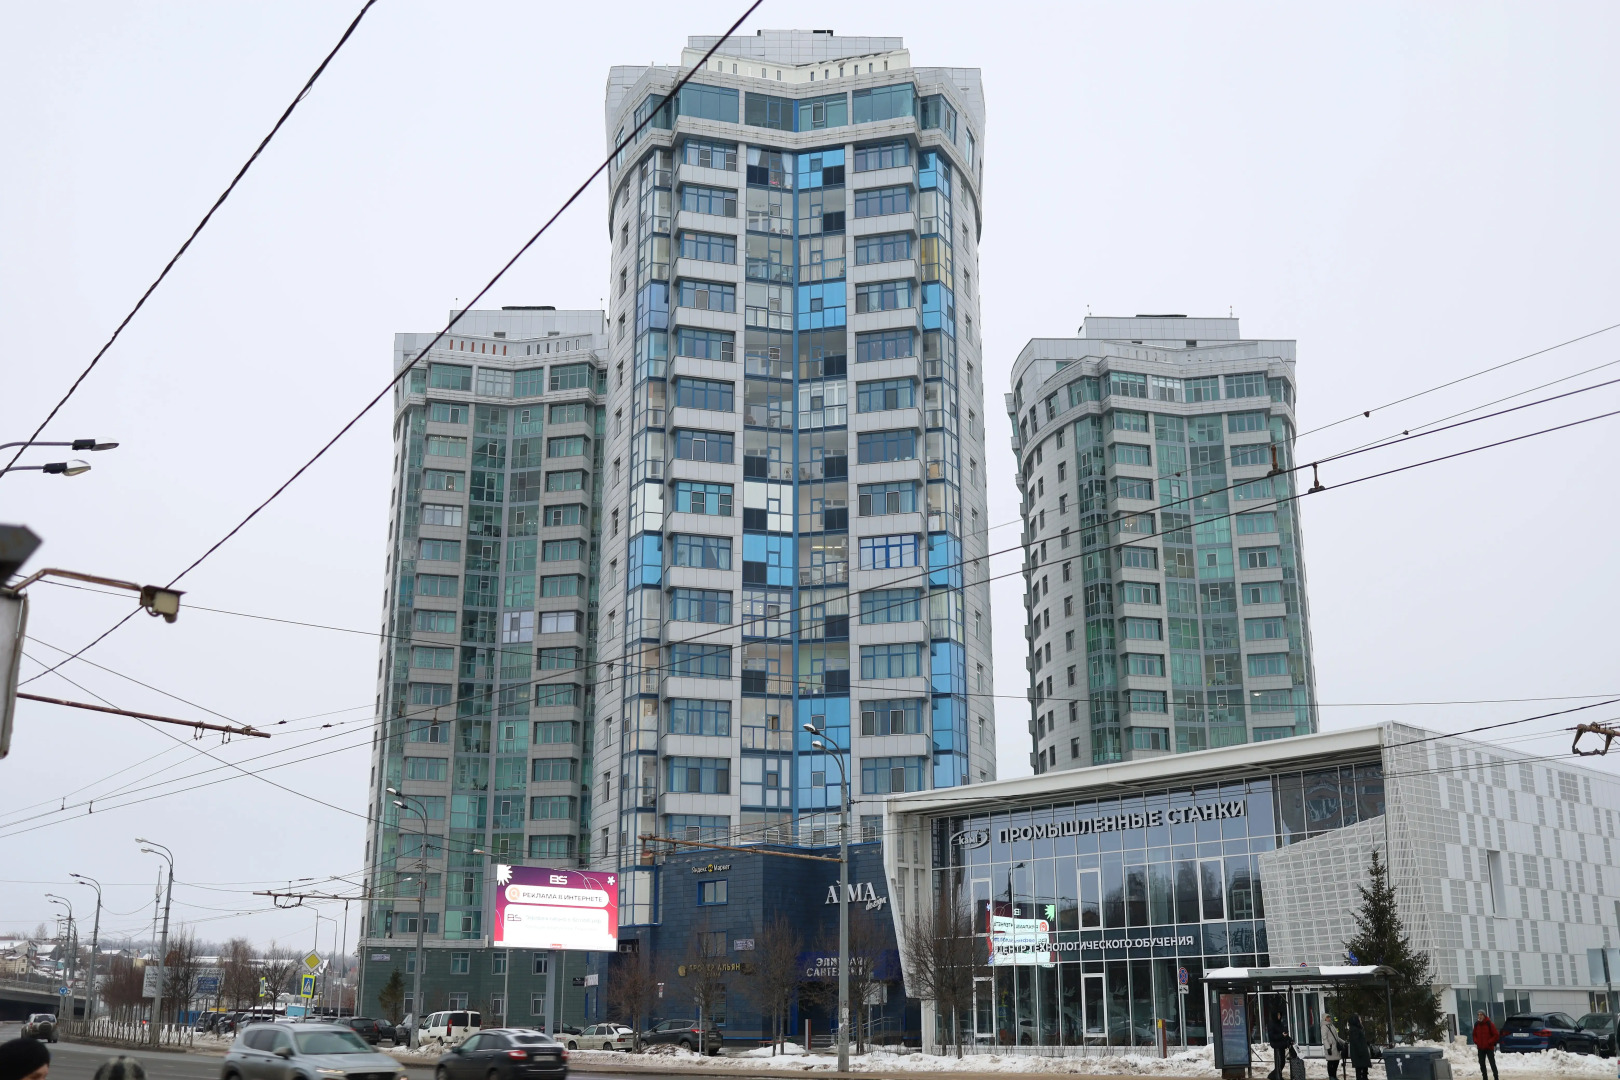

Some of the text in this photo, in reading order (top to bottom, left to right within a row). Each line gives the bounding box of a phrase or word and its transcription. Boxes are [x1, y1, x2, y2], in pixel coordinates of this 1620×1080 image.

[999, 800, 1245, 843] ПРОМЫШЛЕННЫЕ СТАНКИ
[550, 875, 568, 885] BS
[563, 894, 603, 902] ИНТЕРНЕТЕ
[1029, 939, 1132, 952] ТЕХНОЛОГИЧЕСКОГО
[1135, 935, 1194, 948] ОБУЧЕНИЯ
[816, 957, 863, 967] ЭЛИАЯ
